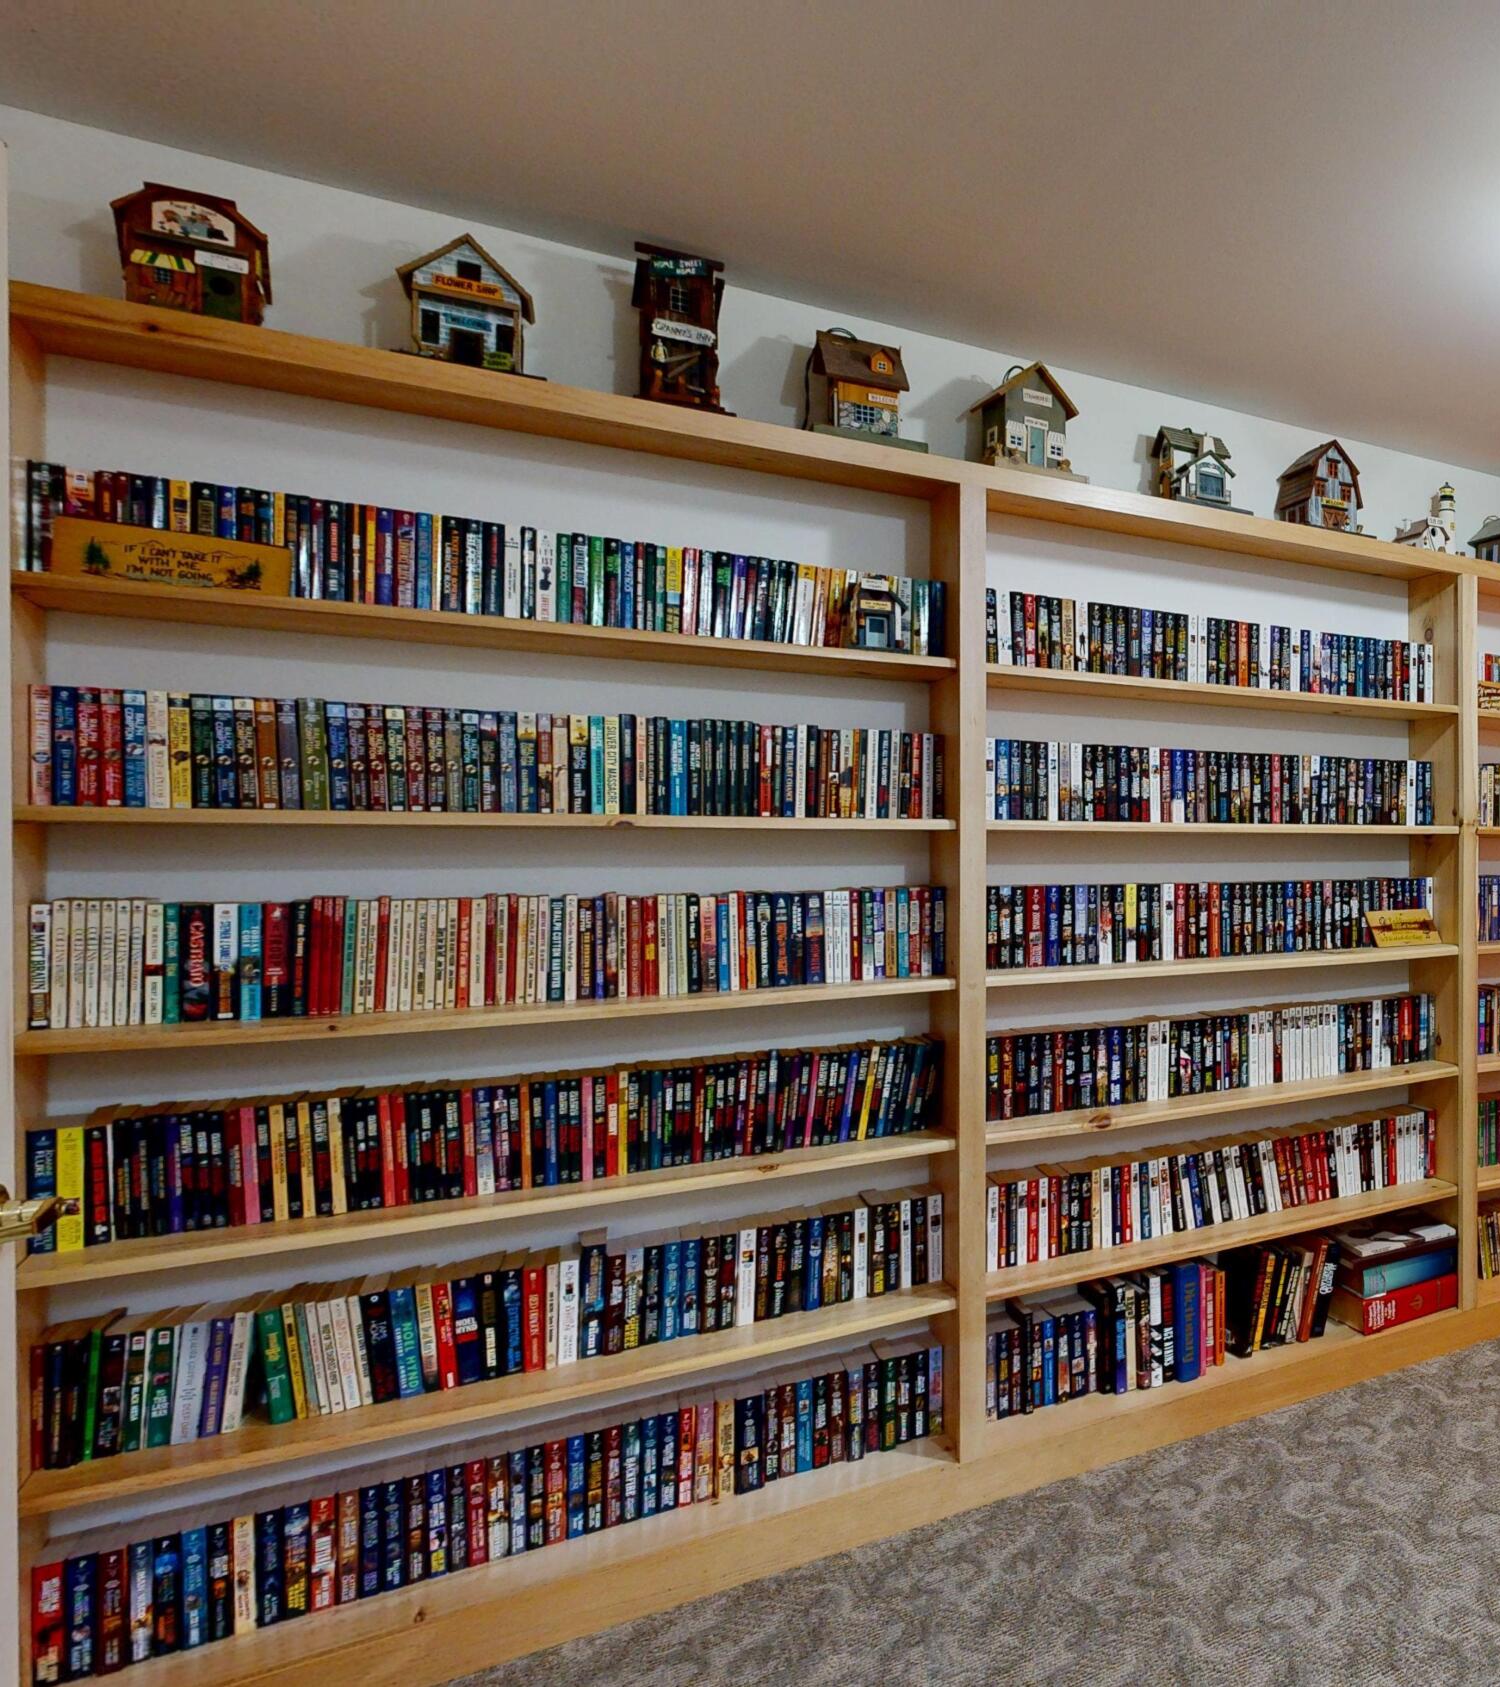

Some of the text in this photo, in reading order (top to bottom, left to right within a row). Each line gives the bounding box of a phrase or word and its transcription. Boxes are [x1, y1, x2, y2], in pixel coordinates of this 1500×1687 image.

[434, 275, 473, 290] FLOWER
[138, 556, 169, 567] WITH
[150, 567, 174, 577] NOT
[178, 570, 213, 582] GOING
[606, 726, 617, 804] SILVER CITY MASSACRE
[551, 910, 561, 930] RALPH
[31, 934, 45, 990] MATT BRAUN
[189, 920, 205, 987] CASTRATO
[551, 931, 561, 957] COTTON
[1182, 1281, 1196, 1363] Dictionary
[402, 1321, 419, 1388] NOEL HYND
[625, 1455, 637, 1496] BACKFIRE
